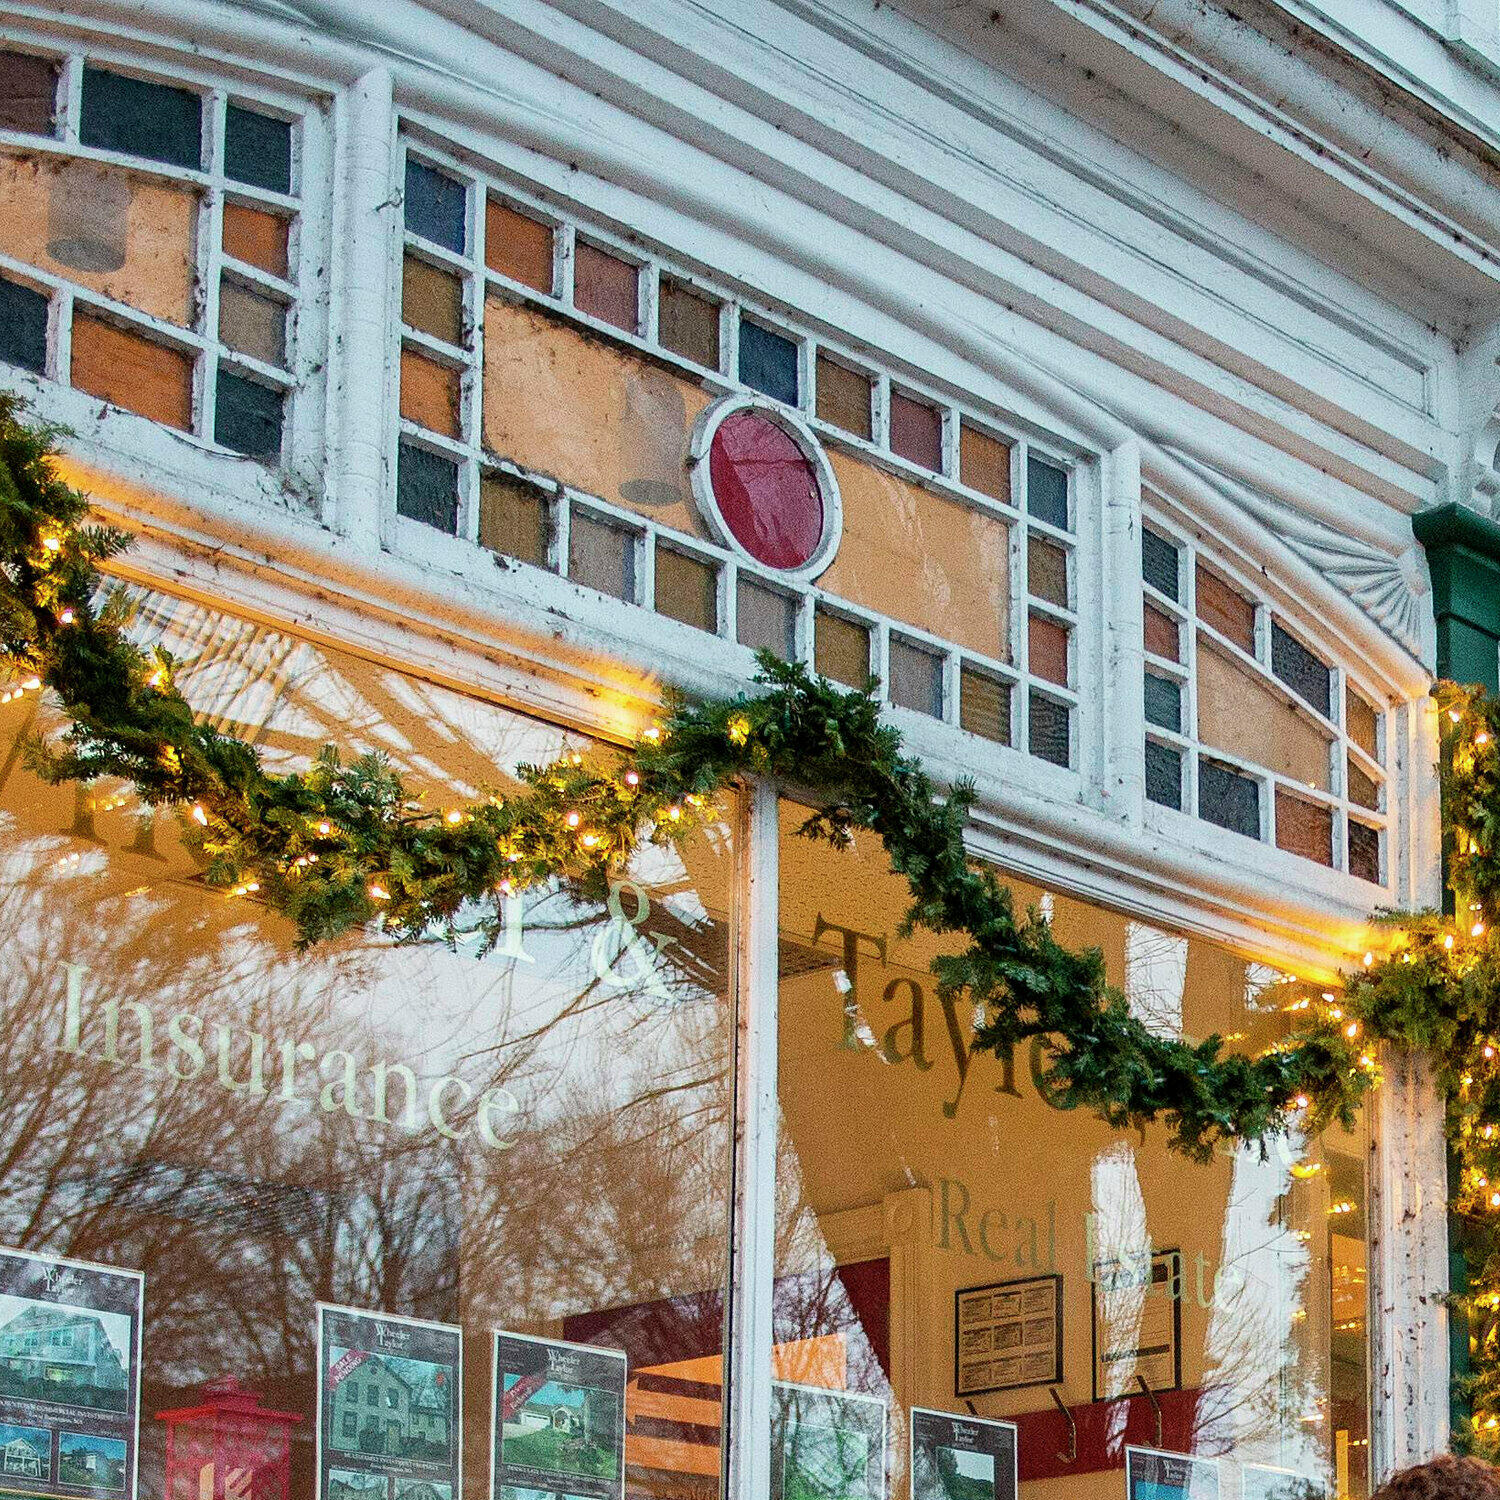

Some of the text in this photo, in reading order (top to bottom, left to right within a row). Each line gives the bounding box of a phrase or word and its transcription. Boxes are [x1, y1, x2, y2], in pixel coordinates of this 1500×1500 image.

[591, 879, 675, 1001] &
[53, 958, 521, 1151] Insurance
[932, 1178, 1057, 1270] Real
[335, 1354, 352, 1371] SALE
